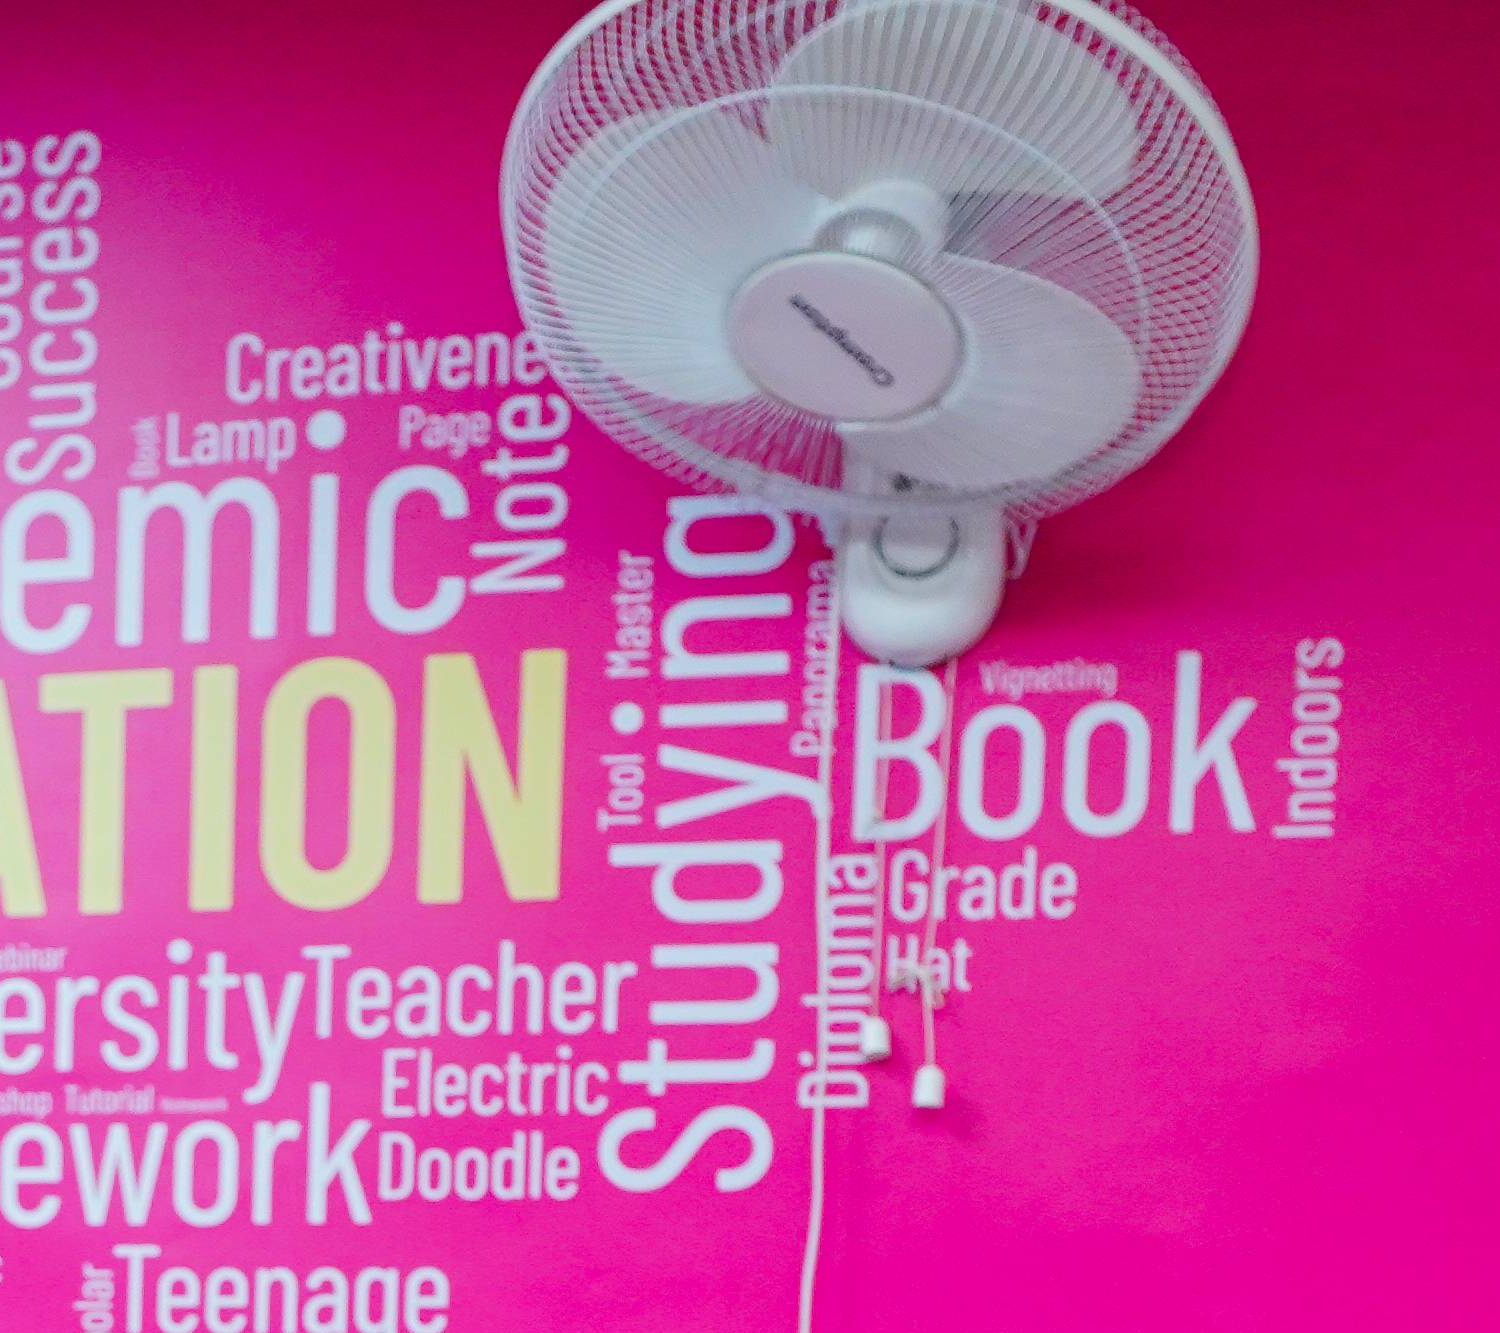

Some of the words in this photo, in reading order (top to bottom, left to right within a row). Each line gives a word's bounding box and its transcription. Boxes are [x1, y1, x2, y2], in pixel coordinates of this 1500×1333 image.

[6, 128, 101, 483] Success
[226, 322, 548, 403] Creativene
[166, 412, 296, 472] Lamp
[400, 403, 492, 458] Page
[469, 394, 571, 595] Note
[609, 548, 656, 679] Master
[979, 657, 1118, 699] Vignetting
[852, 652, 1258, 839] Book
[1273, 636, 1346, 839] Indoors
[599, 753, 646, 831] Tool
[599, 495, 838, 1192] Studying
[889, 846, 1078, 922] Grade
[300, 940, 640, 1042] Teacher
[796, 854, 880, 1108] Diploma
[886, 933, 974, 992] Hat
[64, 1084, 156, 1115] Tutorial
[380, 1045, 610, 1118] Electric
[377, 1133, 580, 1201] Doodle
